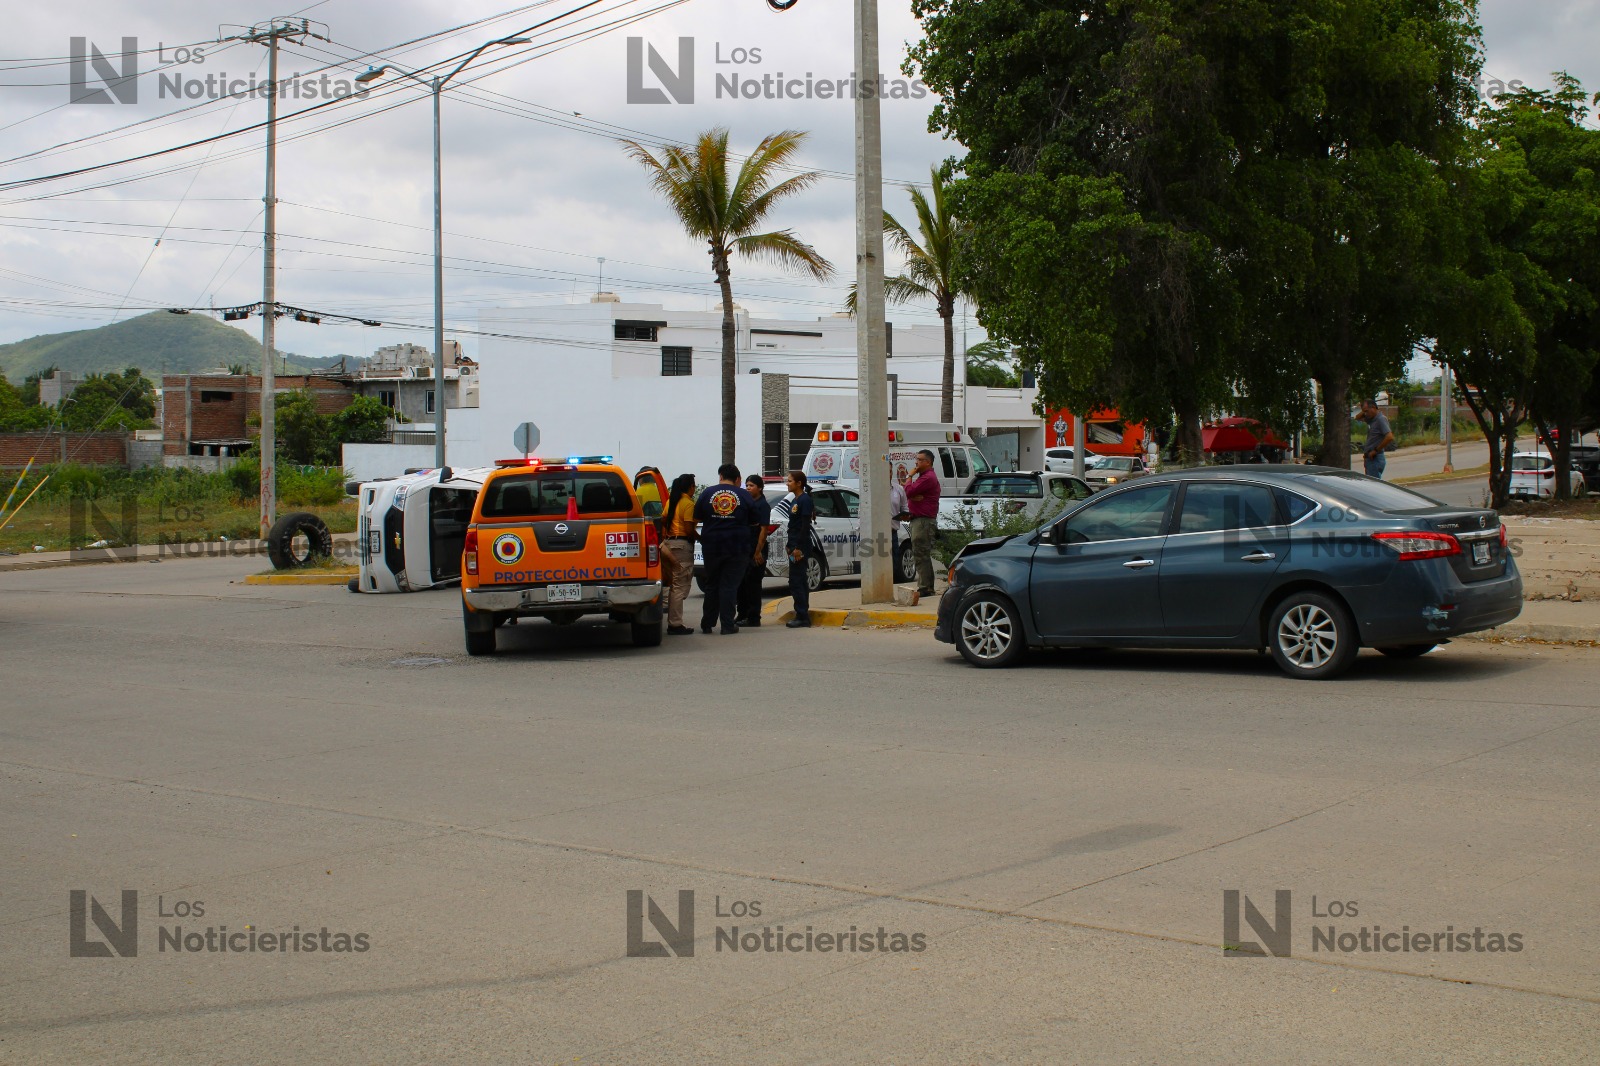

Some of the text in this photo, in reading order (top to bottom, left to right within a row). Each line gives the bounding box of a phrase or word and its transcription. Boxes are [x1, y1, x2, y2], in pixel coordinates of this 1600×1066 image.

[608, 533, 635, 543] 911
[823, 533, 861, 543] POLICÍA TRÁ
[494, 566, 630, 582] PROTECCIÓN CIVIL
